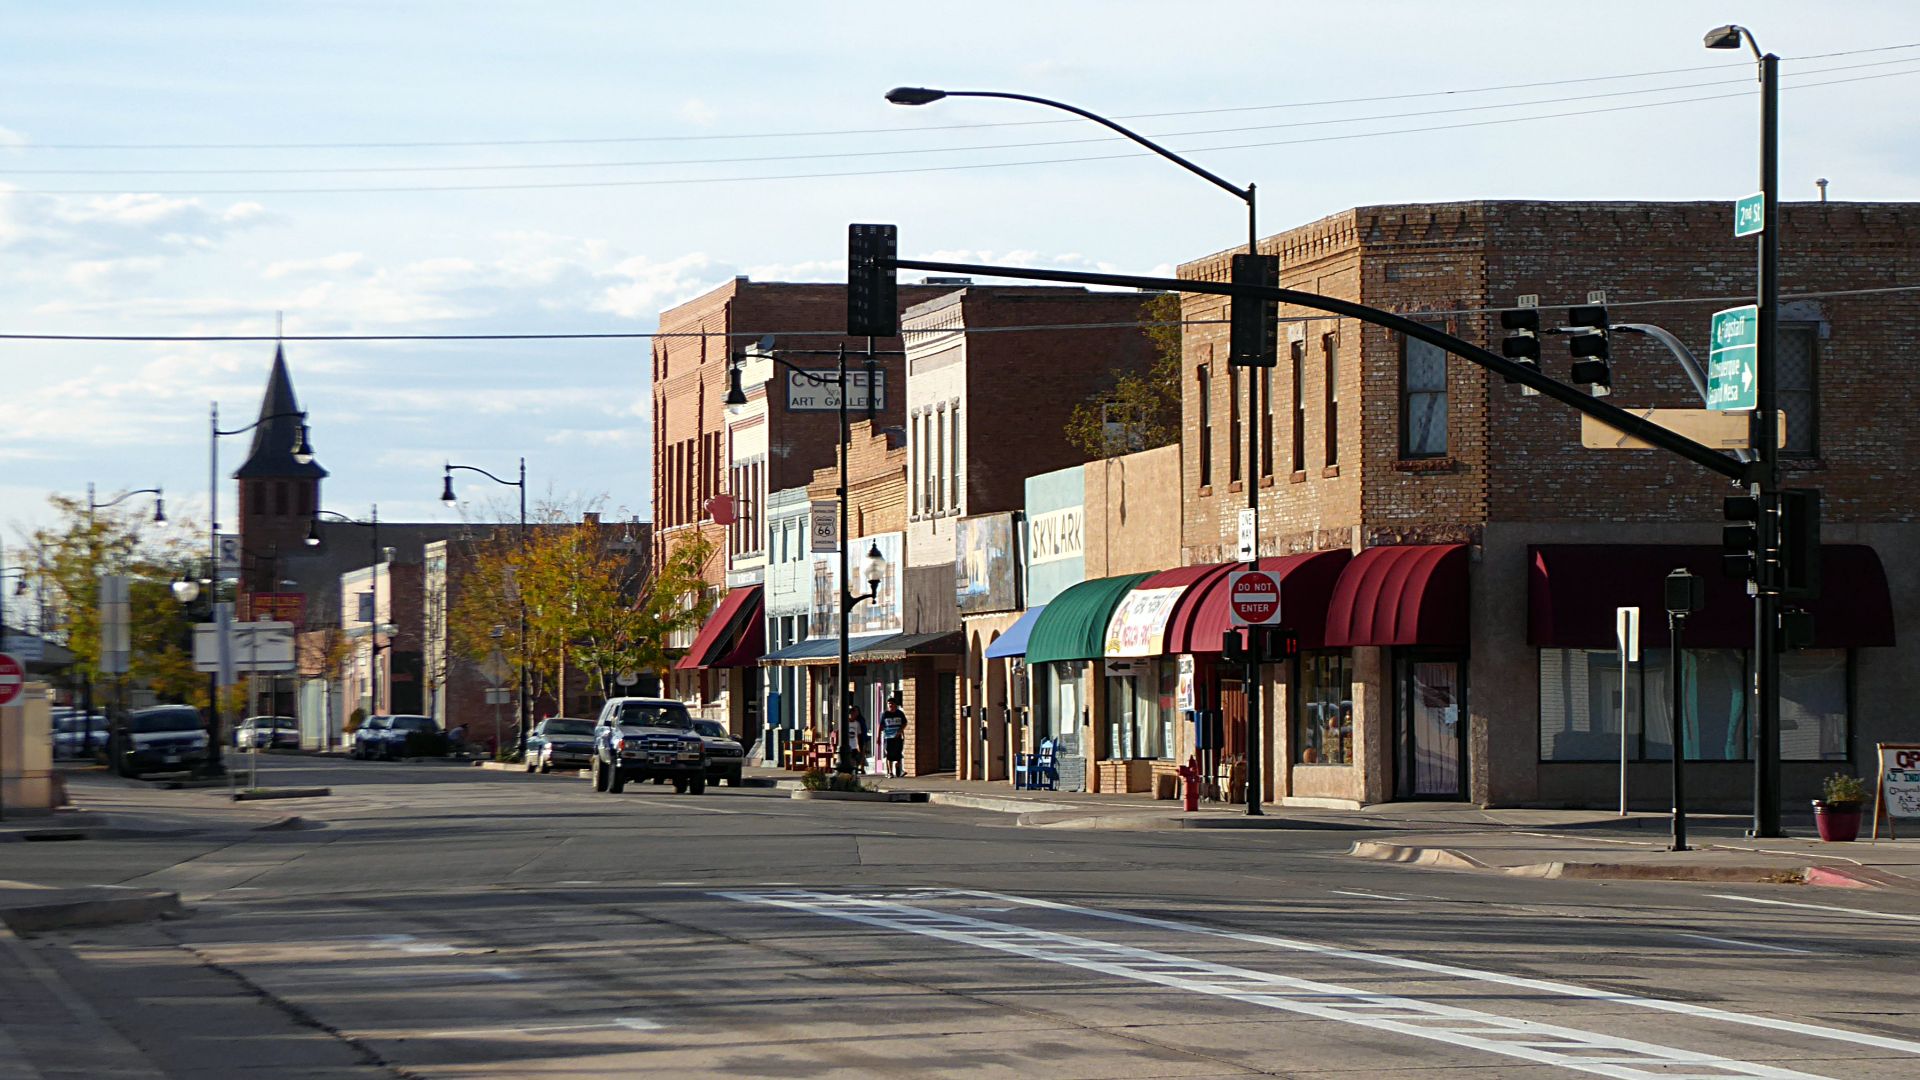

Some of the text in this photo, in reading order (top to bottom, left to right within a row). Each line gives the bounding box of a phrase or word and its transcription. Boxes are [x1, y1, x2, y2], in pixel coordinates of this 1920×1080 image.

[1740, 202, 1761, 226] 2nd St
[1721, 315, 1745, 343] Flagstaff
[1723, 384, 1739, 401] Mesa
[791, 396, 882, 407] ART GALEY
[1241, 513, 1252, 526] ONE
[817, 525, 831, 535] 66
[1032, 511, 1082, 559] SKYLARK
[1241, 529, 1252, 540] WAY
[1238, 582, 1272, 592] DO NOT
[1241, 603, 1270, 613] ENTER
[1886, 774, 1898, 782] AZ
